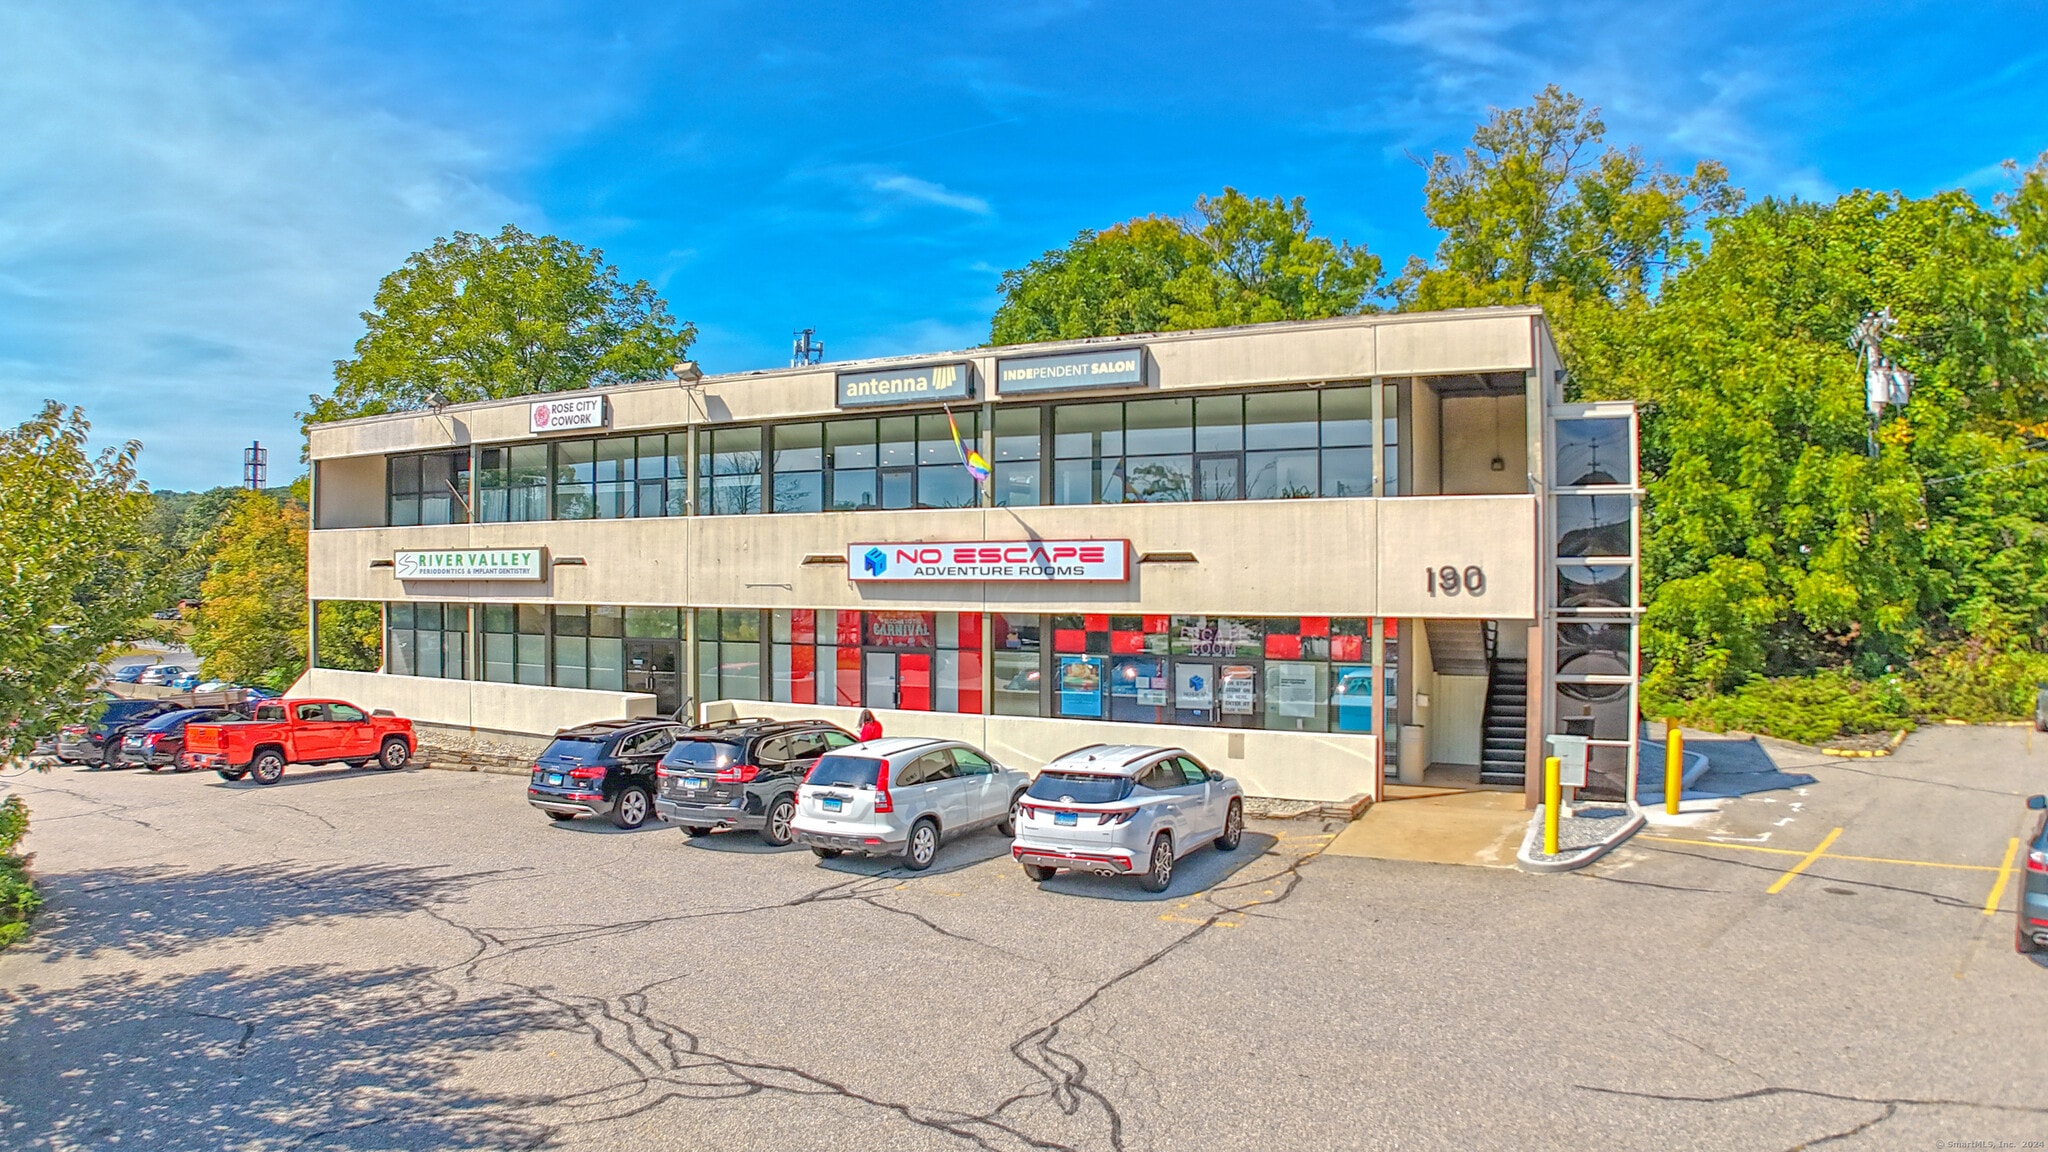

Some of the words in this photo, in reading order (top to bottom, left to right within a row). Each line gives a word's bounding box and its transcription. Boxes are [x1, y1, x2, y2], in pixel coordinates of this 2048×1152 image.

[1003, 363, 1089, 381] INDEPENDENT
[1091, 360, 1135, 375] SALON
[846, 376, 928, 397] antenna
[551, 402, 574, 414] ROSE
[576, 400, 597, 411] CITY
[551, 413, 591, 426] COWORK
[418, 553, 464, 567] RIVER
[468, 552, 531, 566] VALLEY
[896, 548, 942, 564] NO
[953, 547, 1105, 564] ESCAPE
[914, 566, 1013, 576] ADVENTURE
[1019, 566, 1085, 576] ROOMS
[1425, 565, 1482, 593] 190
[873, 622, 930, 636] CARNIVAL
[1180, 626, 1248, 641] ESCAPE
[1190, 642, 1236, 655] ROOM
